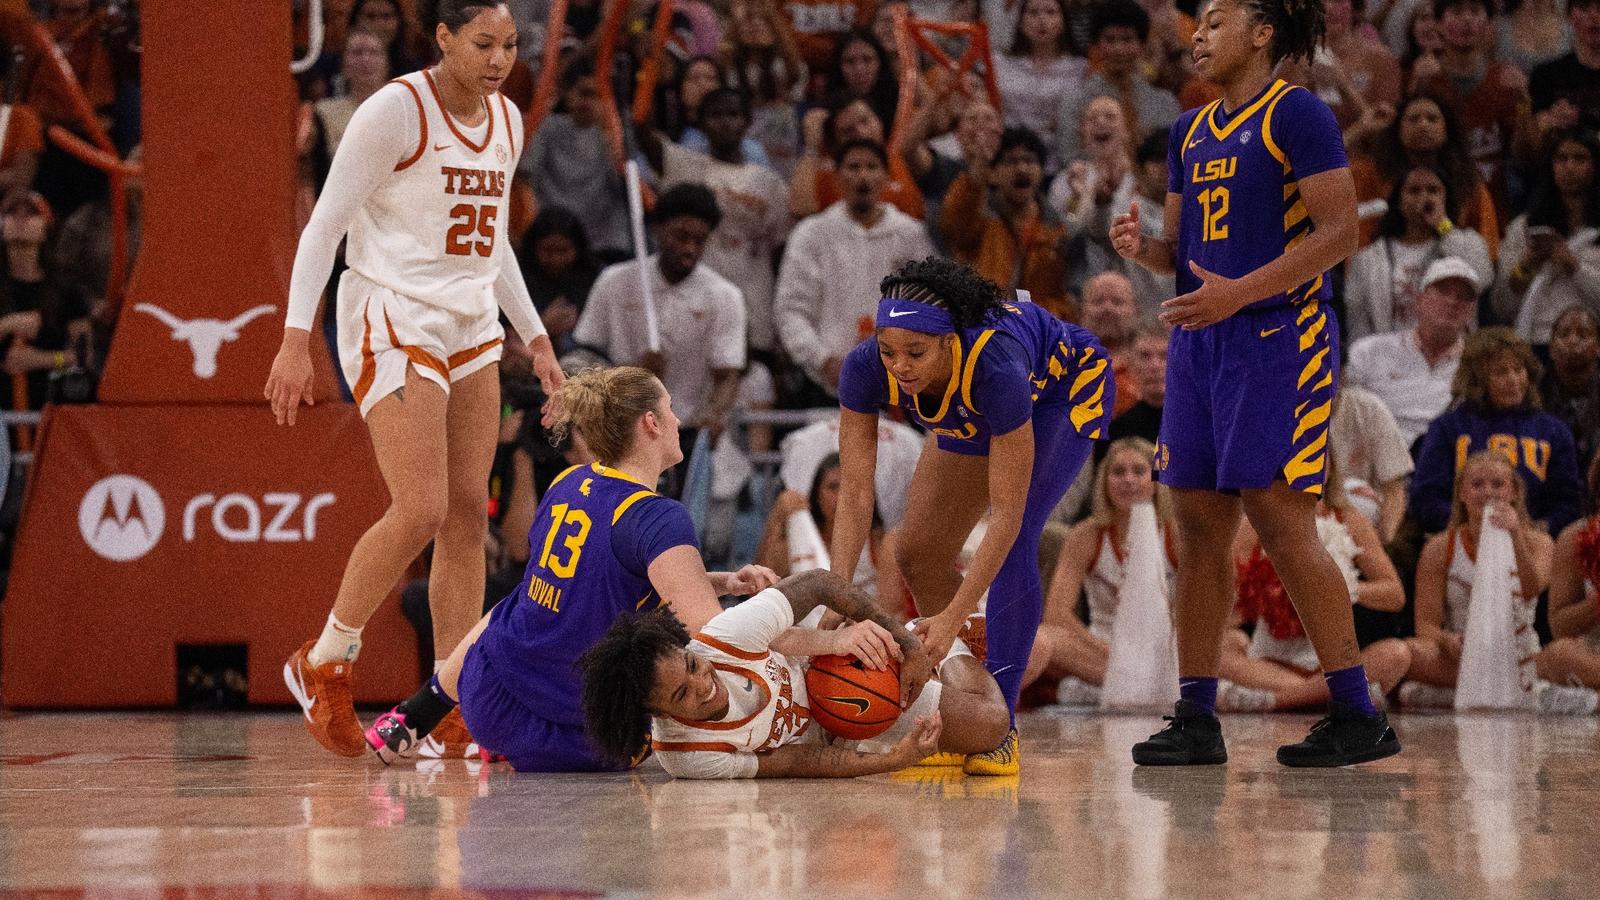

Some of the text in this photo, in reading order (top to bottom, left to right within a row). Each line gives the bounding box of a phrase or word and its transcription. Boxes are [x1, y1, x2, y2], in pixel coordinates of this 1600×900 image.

[441, 166, 505, 197] TEXAS
[1192, 156, 1237, 183] LSU
[445, 203, 497, 257] 25
[1197, 186, 1229, 242] 12
[182, 492, 337, 542] razr
[539, 503, 592, 578] 13
[528, 574, 561, 613] KOVAL
